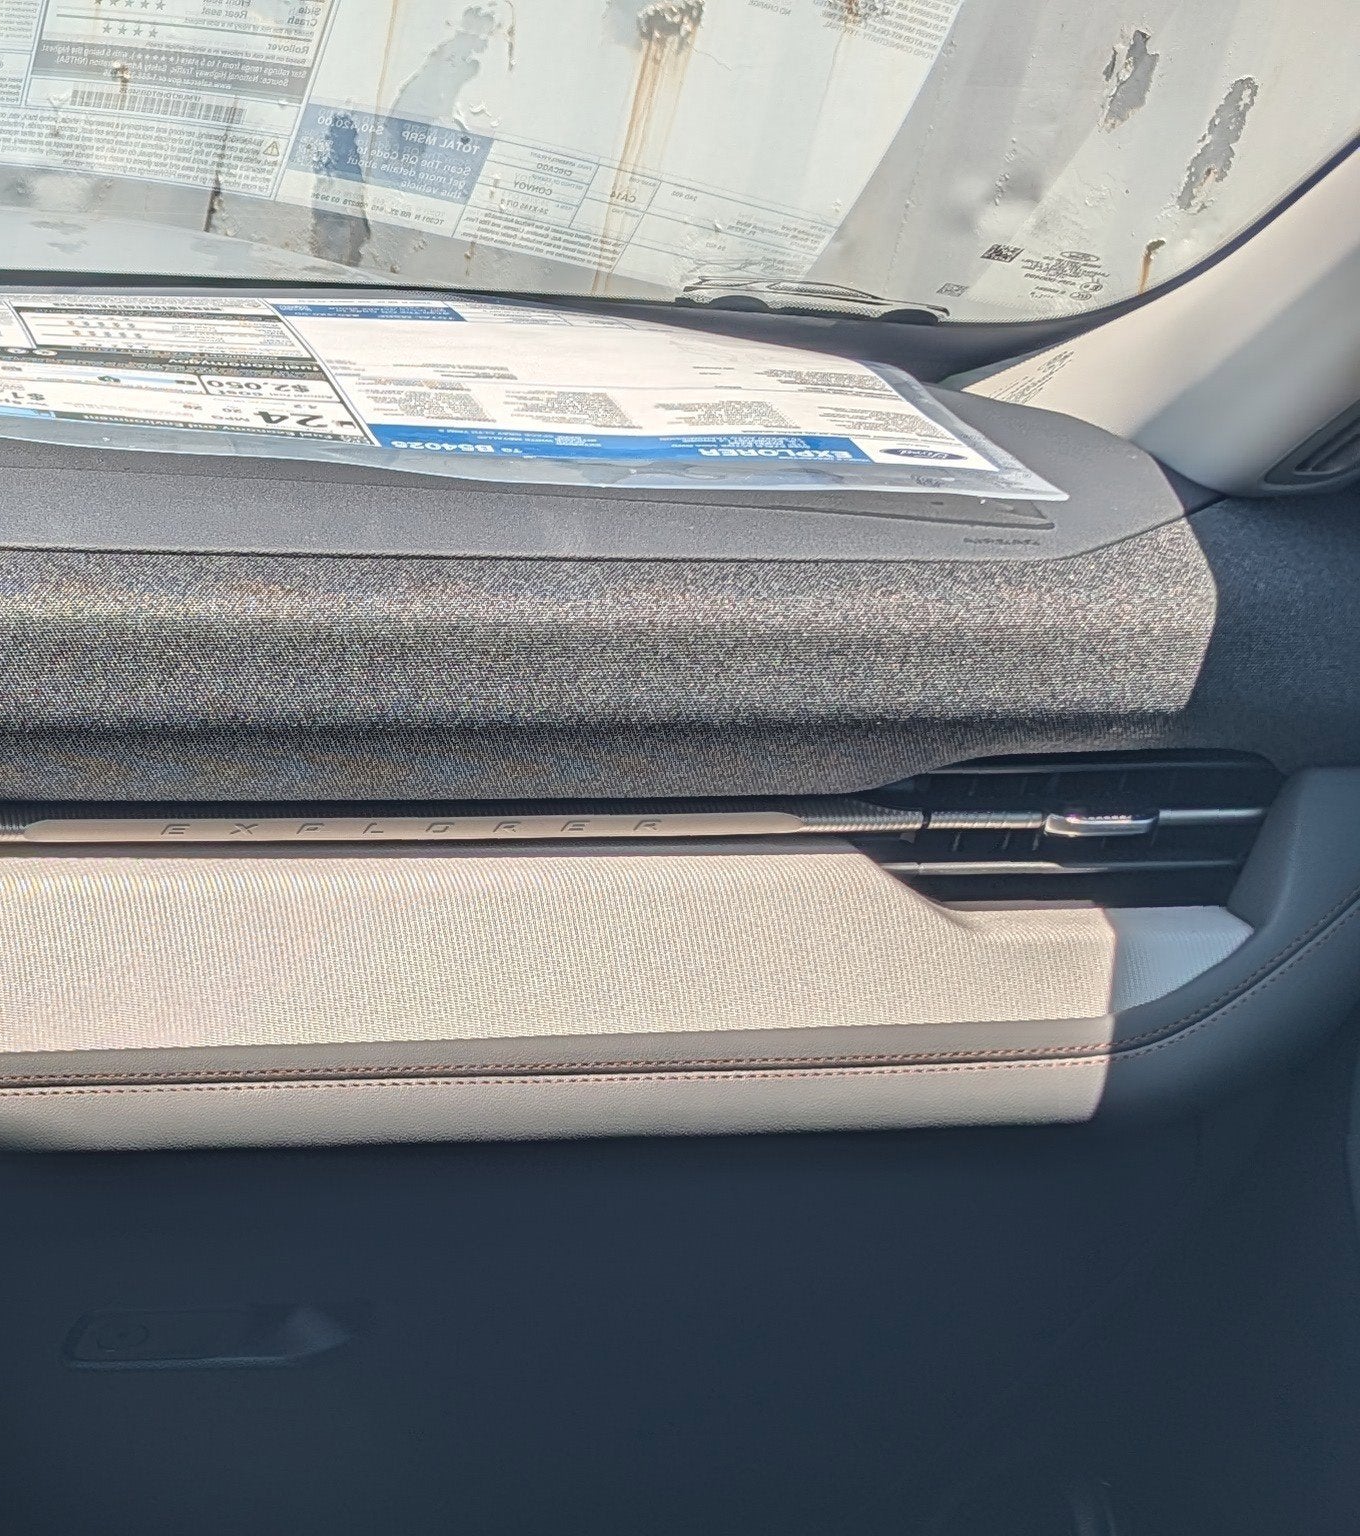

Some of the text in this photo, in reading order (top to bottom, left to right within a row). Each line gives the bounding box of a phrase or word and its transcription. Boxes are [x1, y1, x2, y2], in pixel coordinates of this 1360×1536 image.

[254, 412, 327, 428] 24
[697, 448, 853, 460] EXPLORER
[160, 818, 663, 836] EXPLORER
